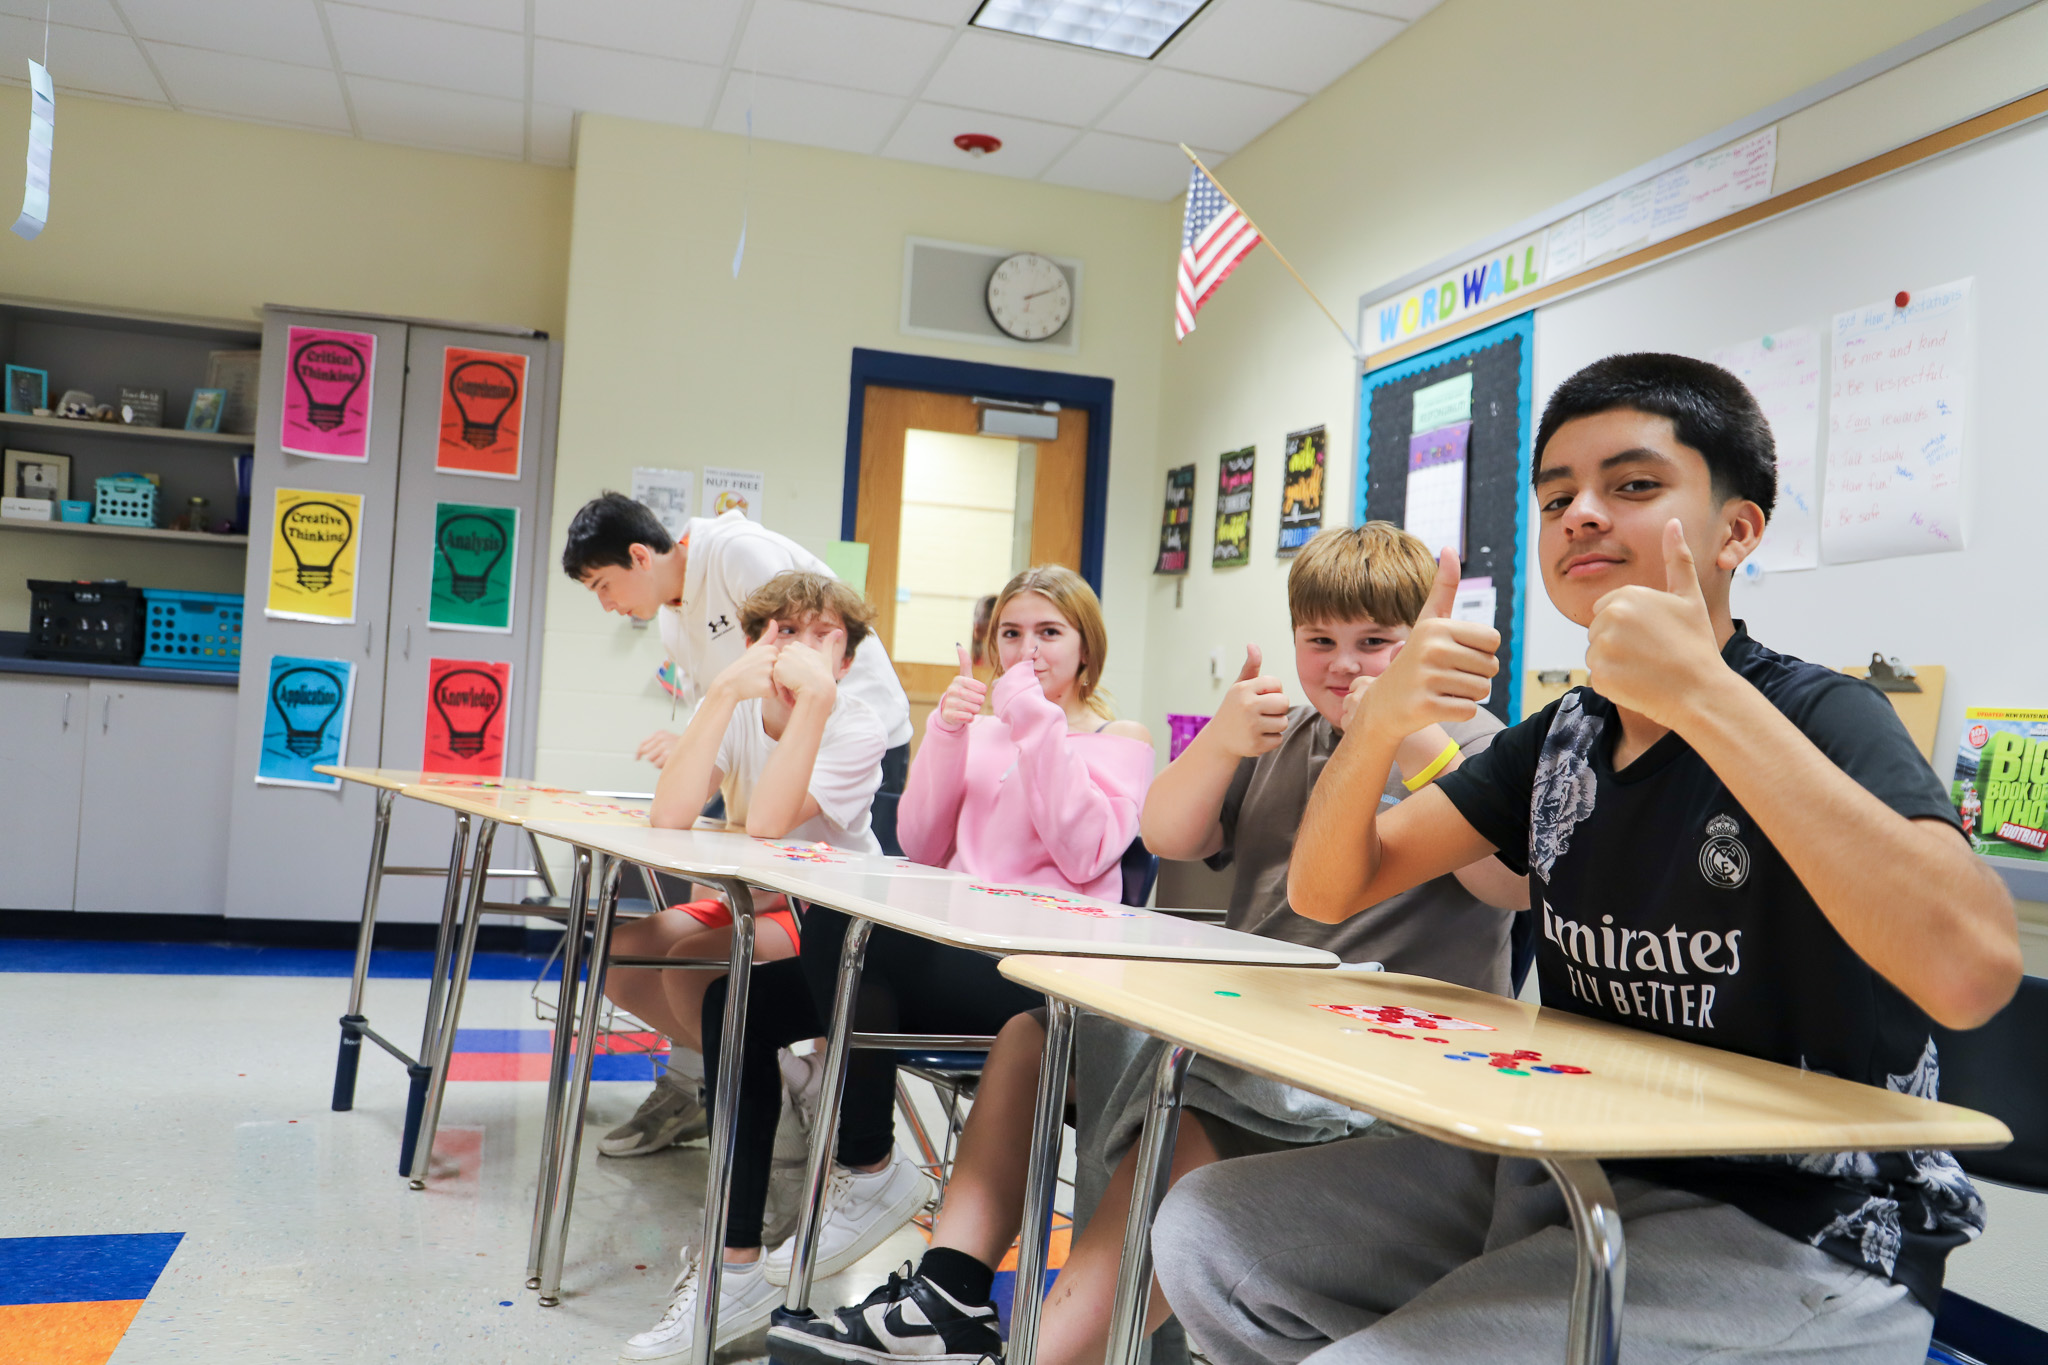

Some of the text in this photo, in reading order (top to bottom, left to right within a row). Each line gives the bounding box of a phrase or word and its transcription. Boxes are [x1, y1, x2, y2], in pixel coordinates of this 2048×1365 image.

[1380, 245, 1538, 343] WORD WALL
[1889, 339, 1913, 359] and
[1918, 330, 1948, 349] kind
[306, 349, 354, 367] Critical
[301, 364, 358, 385] Thinking
[1848, 378, 1865, 397] Be
[1871, 444, 1905, 463] slowly
[706, 477, 729, 488] NUT
[290, 511, 344, 526] Creative
[288, 526, 345, 544] Thinking
[445, 531, 500, 555] Analysis
[280, 685, 337, 709] Application
[441, 686, 497, 711] Knowledge
[1989, 731, 2048, 784] BIG
[1989, 782, 2031, 801] BOOK
[1982, 799, 2046, 834] WHO
[1999, 822, 2047, 849] FOOTBALL
[1543, 898, 1742, 976] Emirates
[1567, 963, 1715, 1028] FLY BETTER
